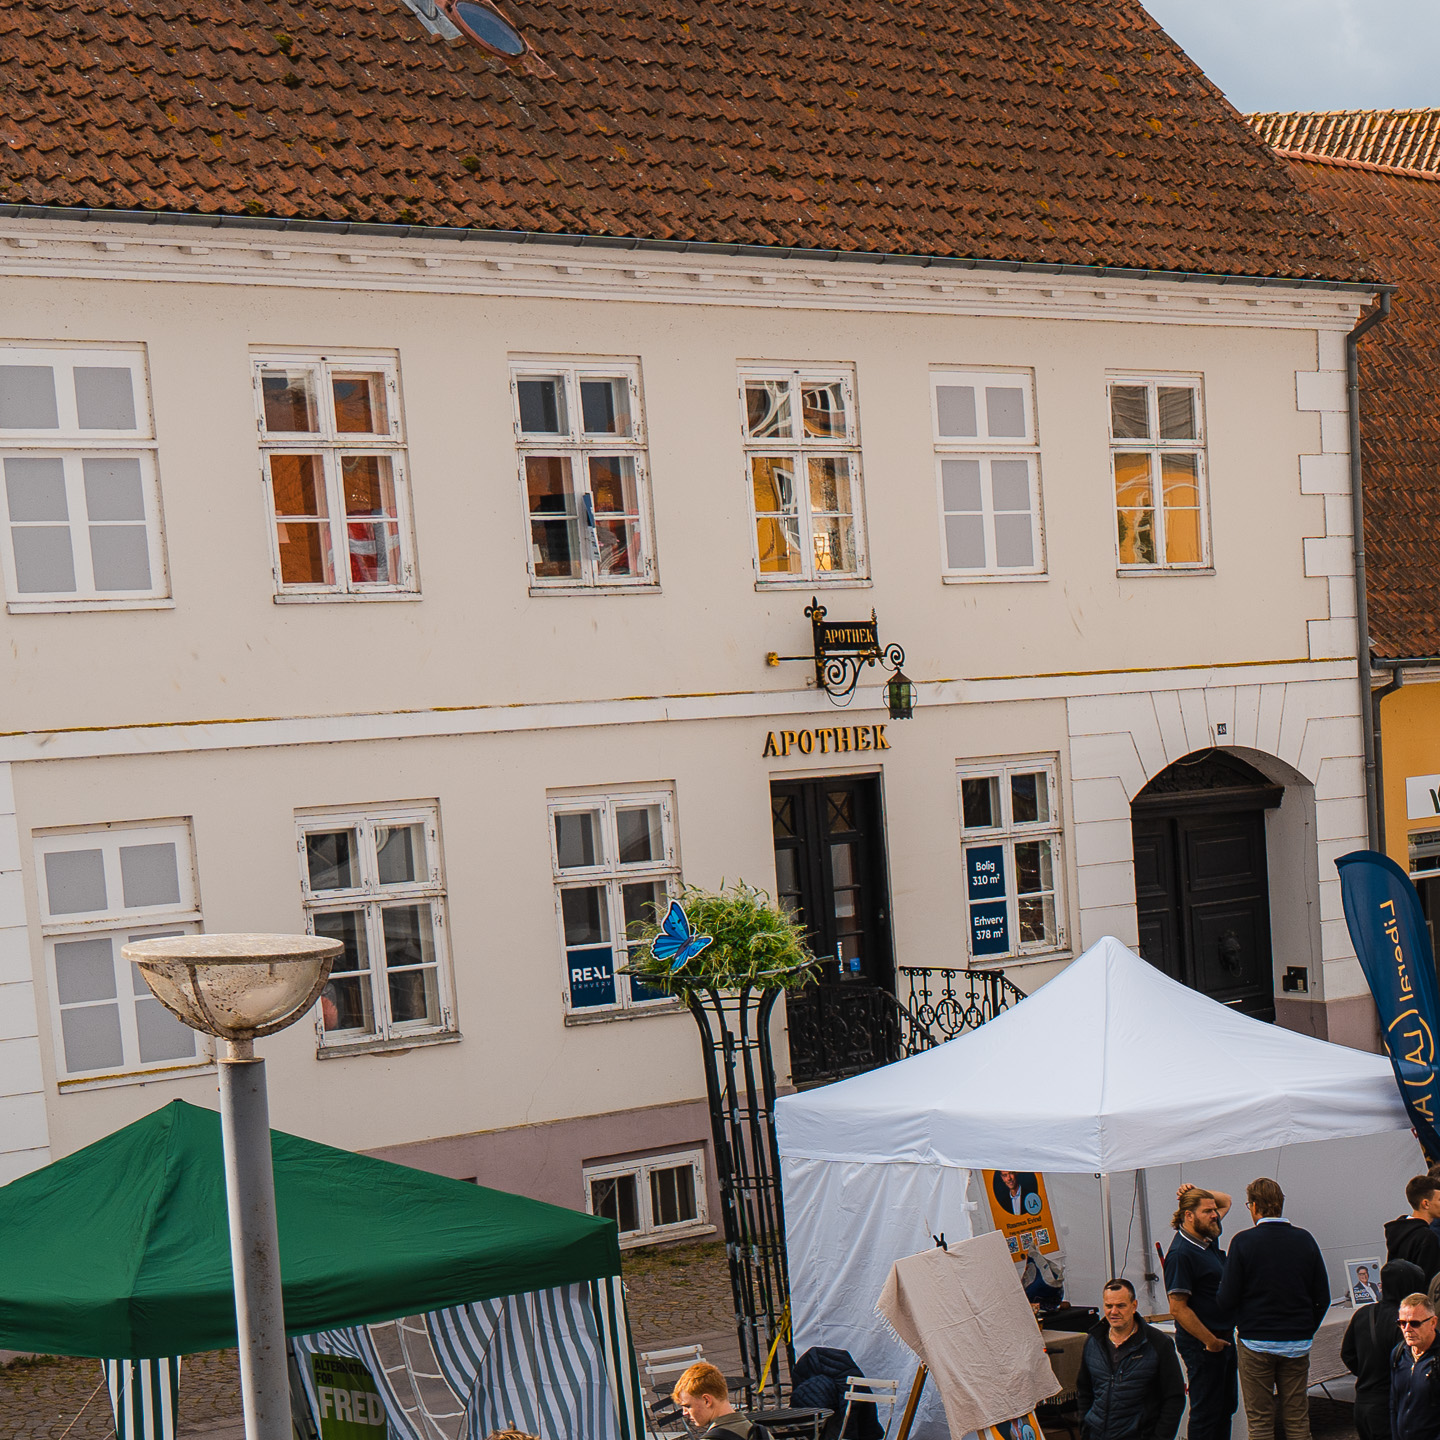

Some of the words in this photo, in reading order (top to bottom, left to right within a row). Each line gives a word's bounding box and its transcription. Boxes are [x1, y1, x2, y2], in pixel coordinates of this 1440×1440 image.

[824, 629, 875, 643] APOTHEK
[763, 725, 891, 758] APOTHEK
[975, 860, 996, 872] Bolig
[972, 875, 988, 886] 310
[974, 916, 1004, 927] Erhverv
[976, 930, 992, 940] 378
[571, 965, 611, 983] REAL
[1028, 1199, 1039, 1209] LA
[316, 1371, 334, 1386] FOR
[317, 1385, 386, 1427] FRED
